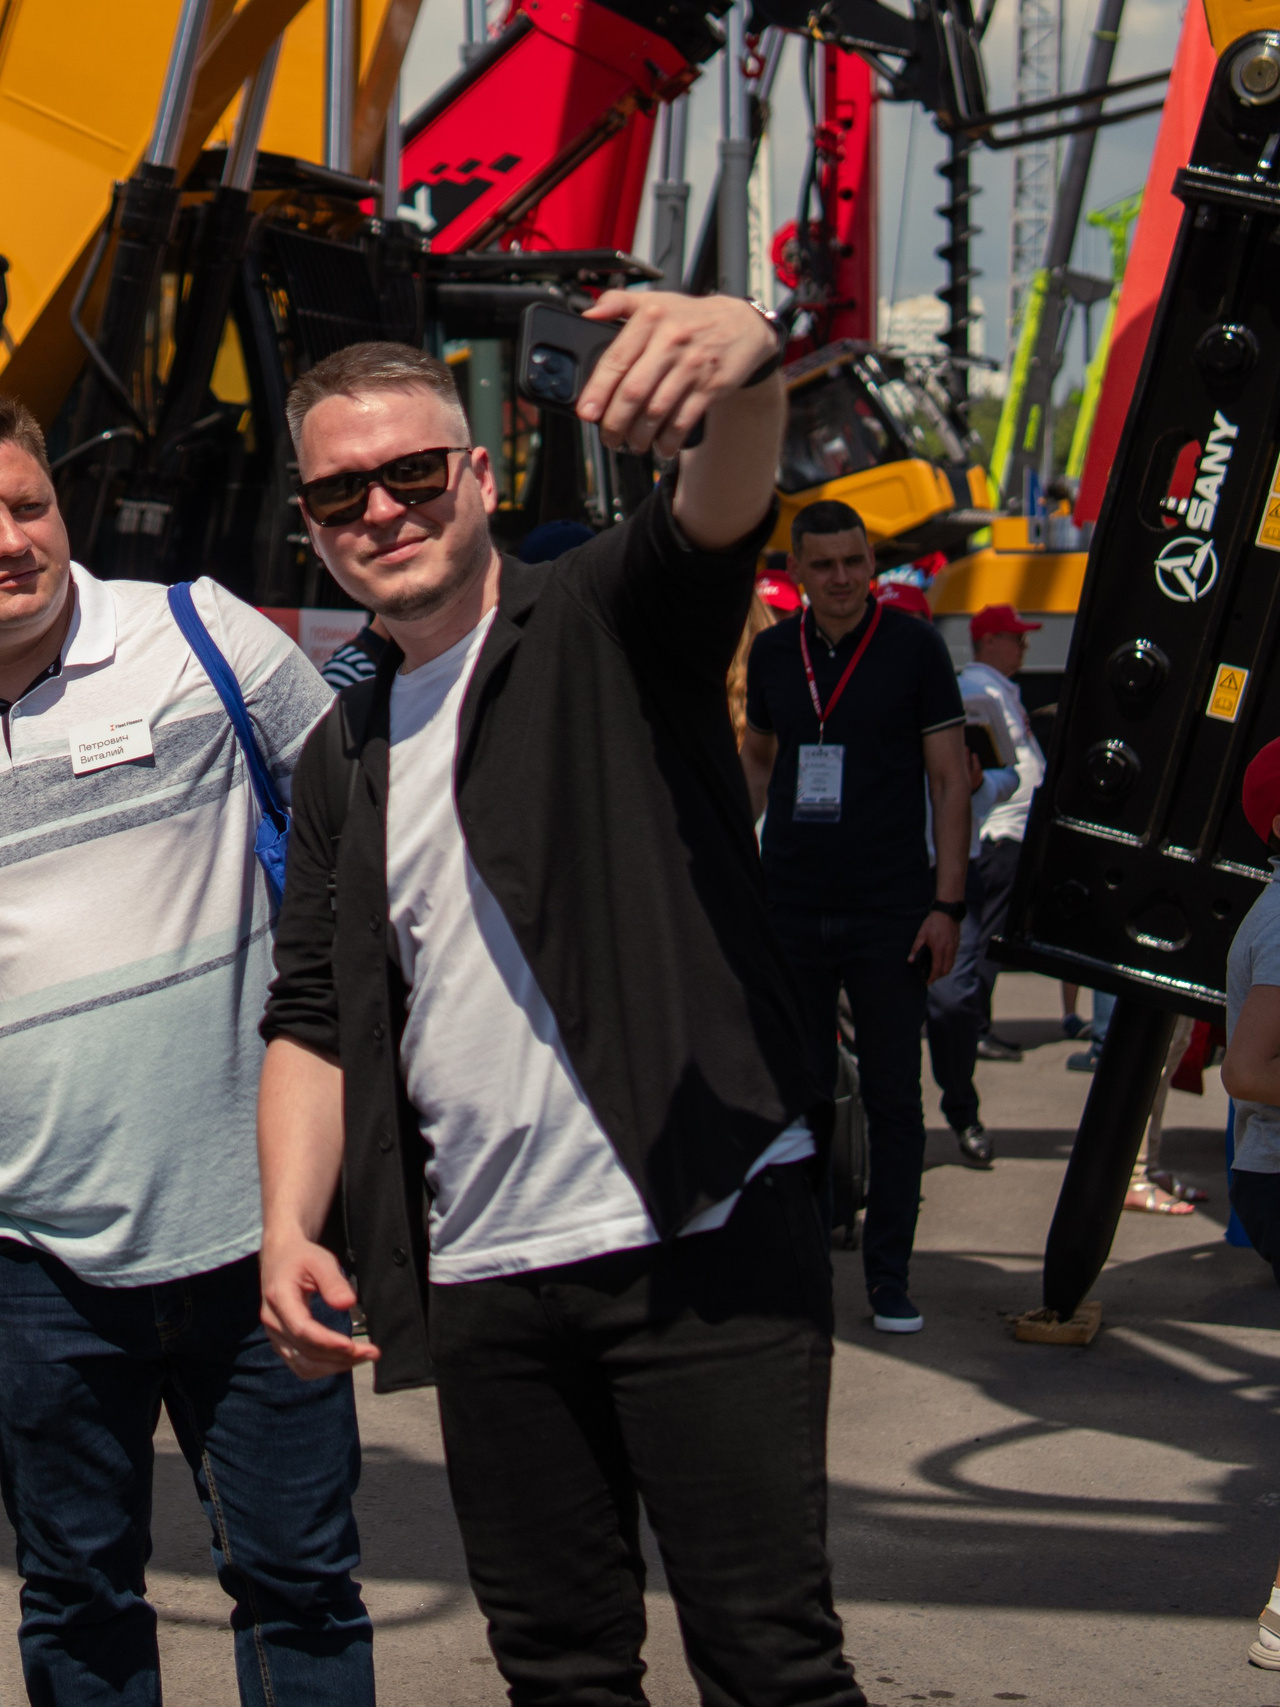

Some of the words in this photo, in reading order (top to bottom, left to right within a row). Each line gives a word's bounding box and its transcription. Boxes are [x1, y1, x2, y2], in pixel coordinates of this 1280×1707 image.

[1186, 409, 1239, 532] SANY
[78, 734, 128, 753] Петрович
[80, 746, 124, 765] Виталий
